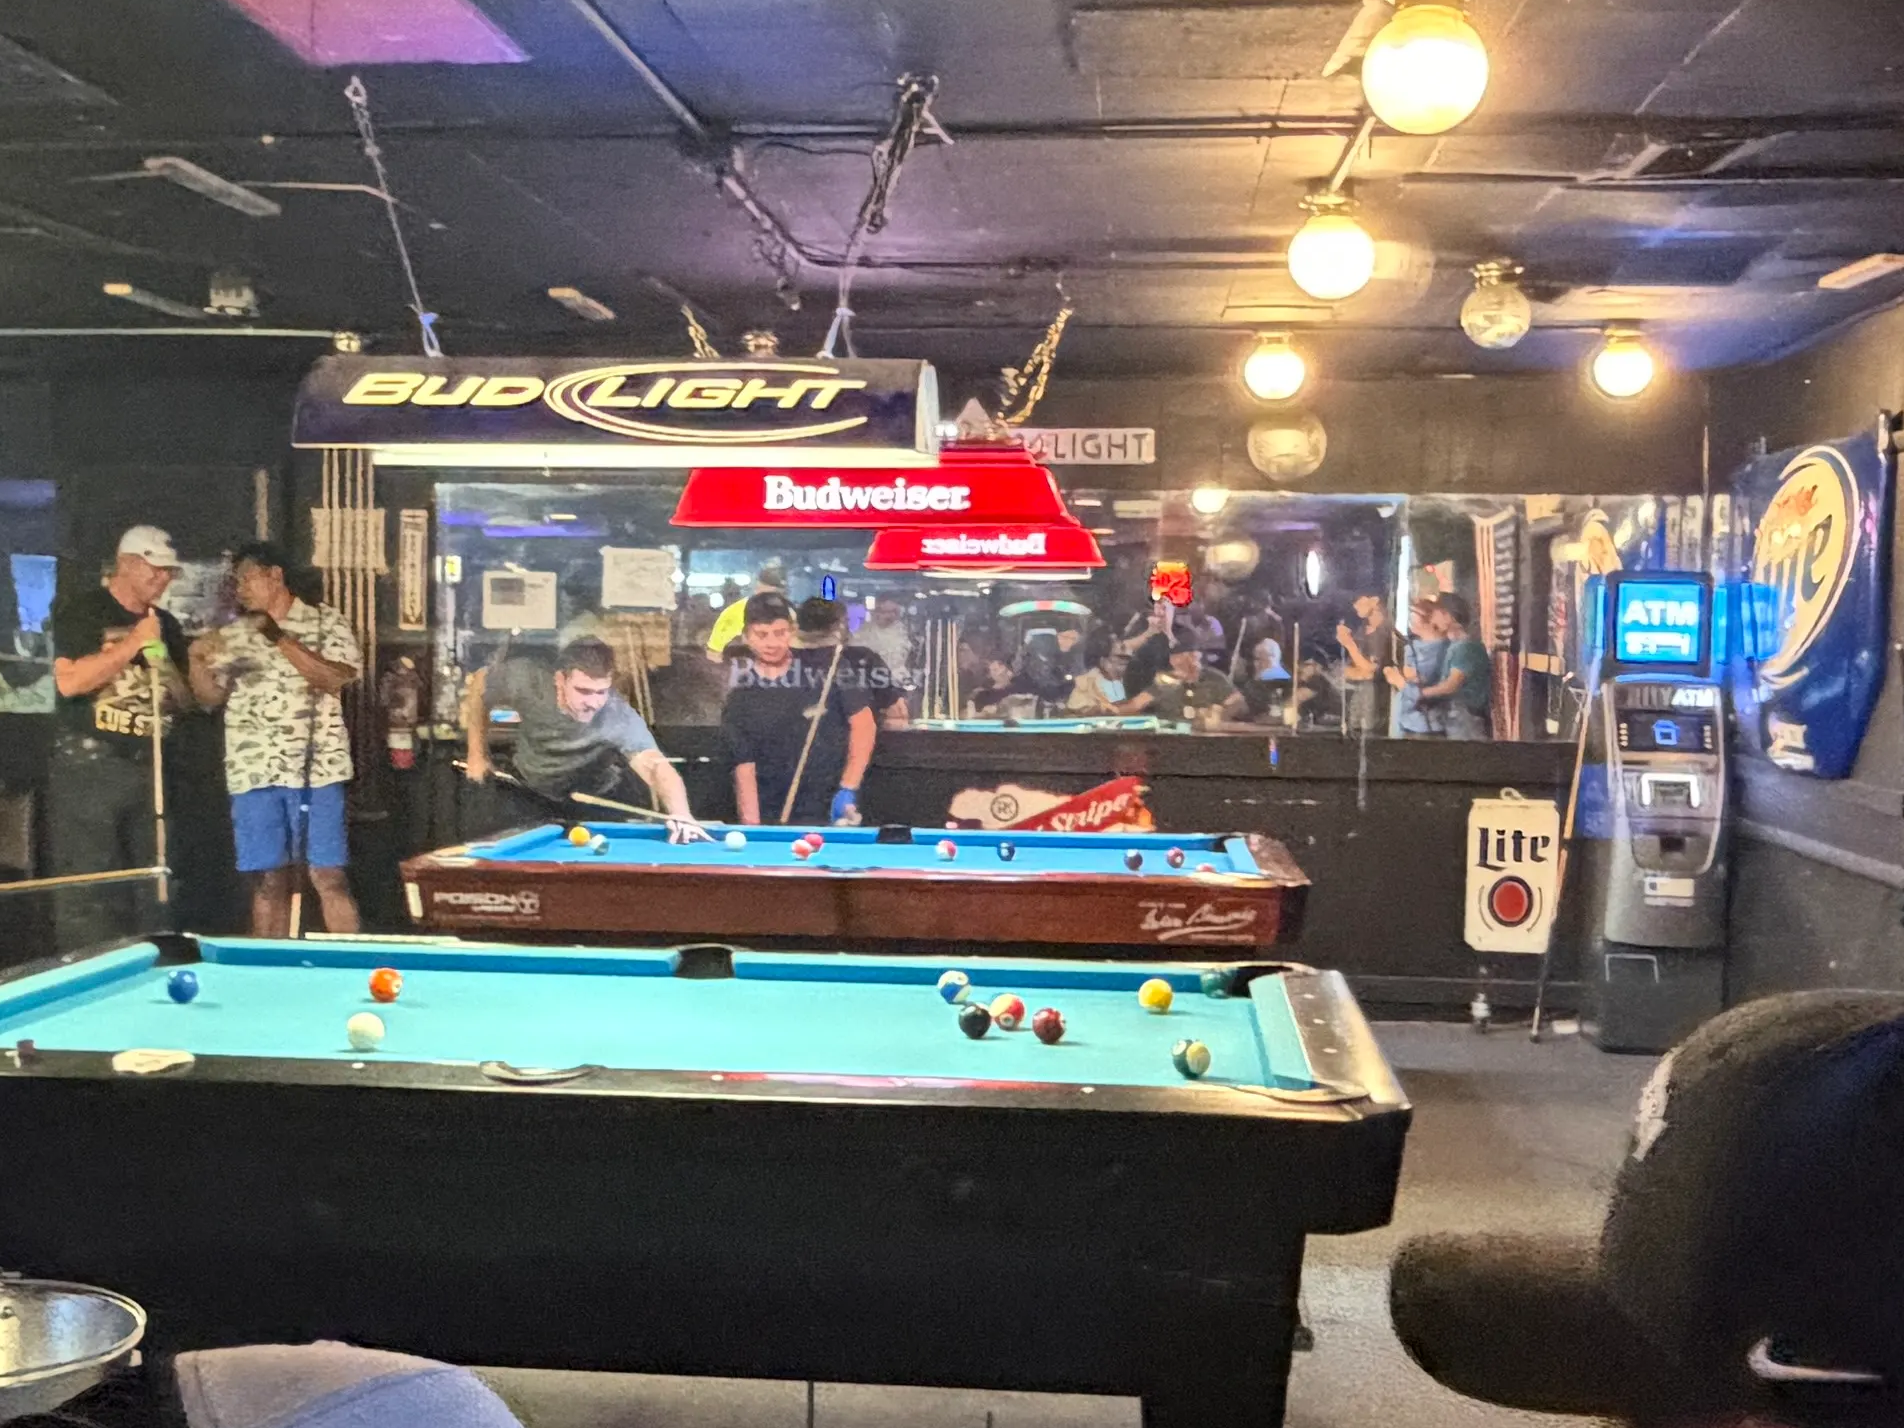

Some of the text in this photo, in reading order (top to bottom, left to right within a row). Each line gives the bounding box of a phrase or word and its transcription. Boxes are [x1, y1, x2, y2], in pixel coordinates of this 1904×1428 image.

[342, 372, 868, 410] BUD LIGHT
[1053, 432, 1152, 460] LIGHT
[762, 474, 972, 511] Budweiser
[1623, 599, 1699, 627] ATM
[1671, 687, 1715, 707] ATM
[1477, 827, 1552, 870] Lite
